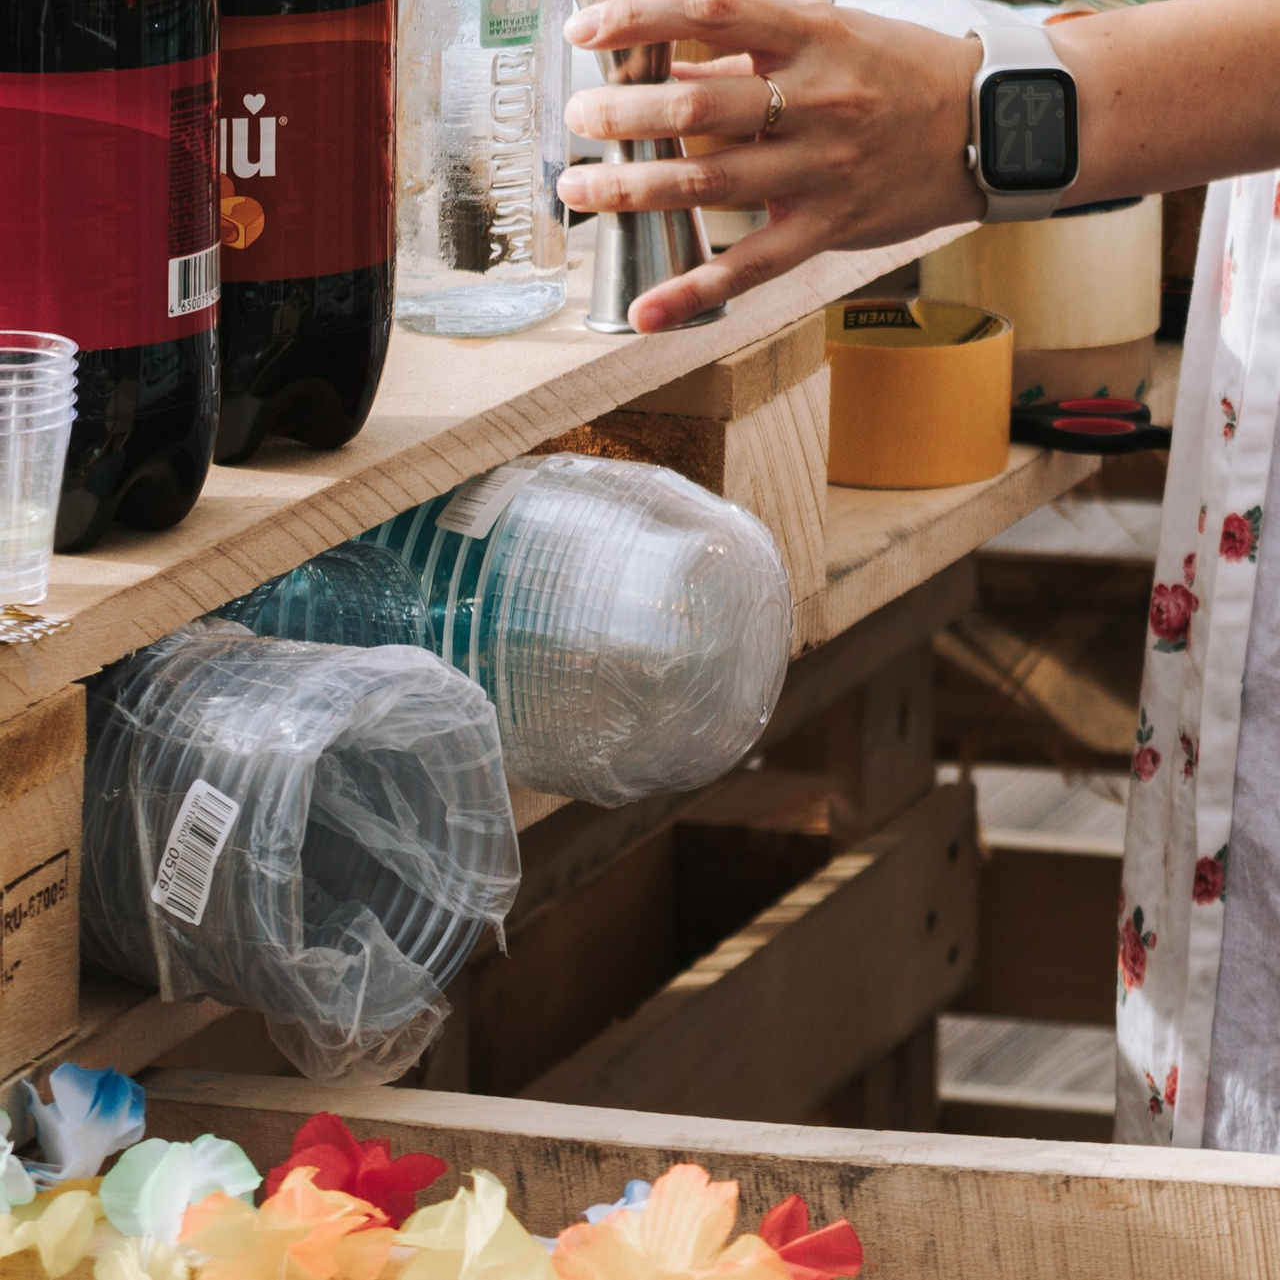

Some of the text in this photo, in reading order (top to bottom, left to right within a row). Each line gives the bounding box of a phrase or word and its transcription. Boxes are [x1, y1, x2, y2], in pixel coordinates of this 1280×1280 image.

[996, 130, 1042, 172] 17
[858, 311, 912, 325] STAYER
[159, 847, 180, 892] 0576
